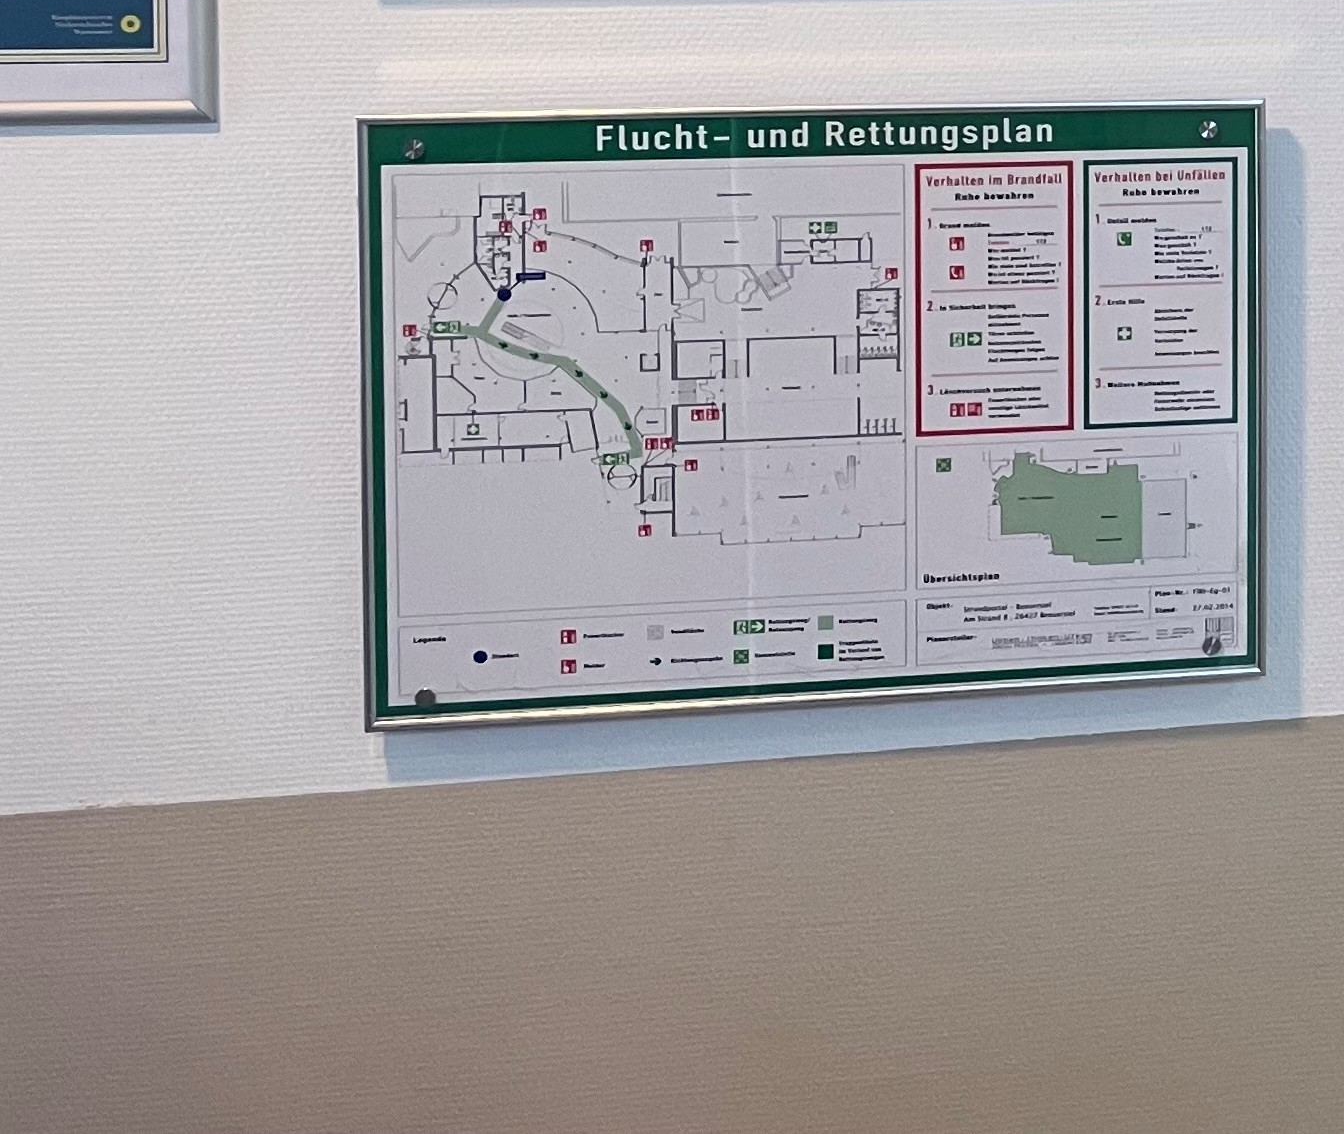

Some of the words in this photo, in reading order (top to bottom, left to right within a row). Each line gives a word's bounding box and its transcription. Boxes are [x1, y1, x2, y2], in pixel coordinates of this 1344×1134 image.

[597, 124, 729, 150] Flucht-
[748, 122, 808, 147] und
[826, 118, 1054, 151] Rettungsplan
[925, 175, 985, 188] Verhalten
[988, 173, 1003, 186] im
[1007, 172, 1063, 186] Brandfall
[1094, 171, 1152, 183] Verhalten
[1155, 170, 1173, 182] bei
[954, 192, 981, 201] Ruhe
[983, 191, 1035, 201] bewahren
[1150, 187, 1200, 196] bewahren
[923, 572, 1000, 584] Übersichtsplan
